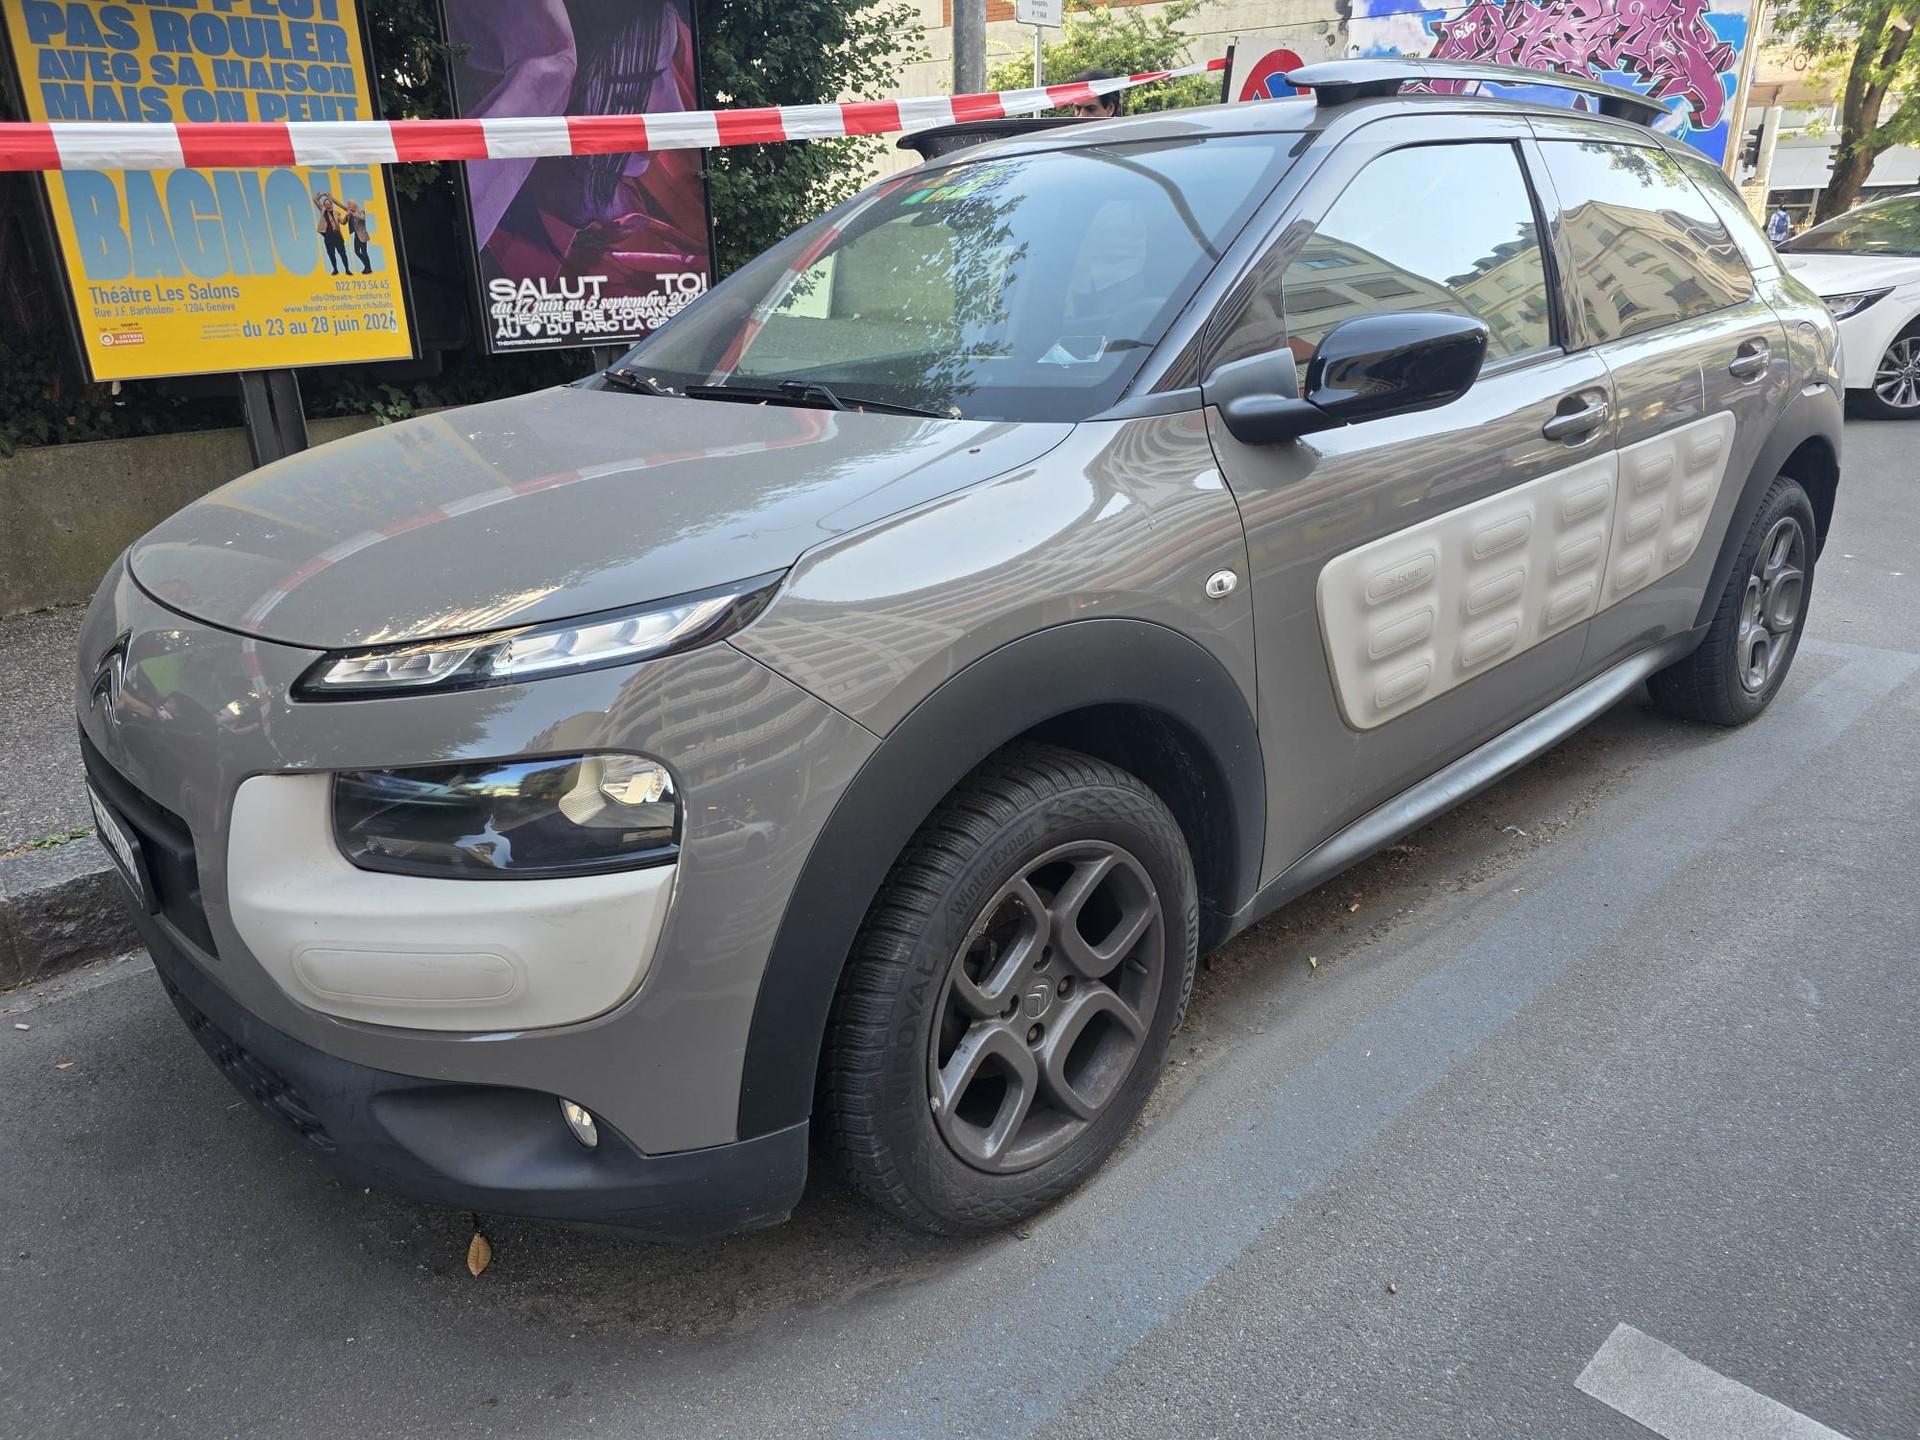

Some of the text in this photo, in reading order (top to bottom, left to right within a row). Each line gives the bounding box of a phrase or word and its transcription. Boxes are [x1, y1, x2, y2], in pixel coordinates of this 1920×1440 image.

[22, 0, 141, 50] PAS
[150, 10, 352, 64] ROULER
[38, 48, 357, 95] AVEC SA MAISON
[40, 82, 359, 122] MAIS ON PEUT
[88, 282, 240, 305] Théâtre Les Salons
[335, 281, 349, 292] 022
[352, 280, 366, 291] 793
[488, 275, 609, 301] SALUT
[94, 307, 112, 318] Rue
[114, 306, 128, 317] J.F.
[184, 303, 204, 313] 1204
[490, 299, 514, 315] du
[530, 296, 565, 315] juin
[565, 299, 586, 311] au
[599, 290, 668, 310] septembre
[667, 290, 708, 305] 202
[581, 309, 605, 321] DE
[242, 320, 262, 338] du
[265, 318, 285, 336] 23
[289, 322, 308, 335] au
[311, 316, 329, 334] 28
[333, 315, 360, 336] juin
[363, 310, 398, 332] 2026
[495, 322, 522, 339] AU
[546, 321, 571, 336] DU
[575, 319, 620, 334] PARC
[623, 318, 645, 331] LA
[949, 822, 1037, 916] WinterExpert
